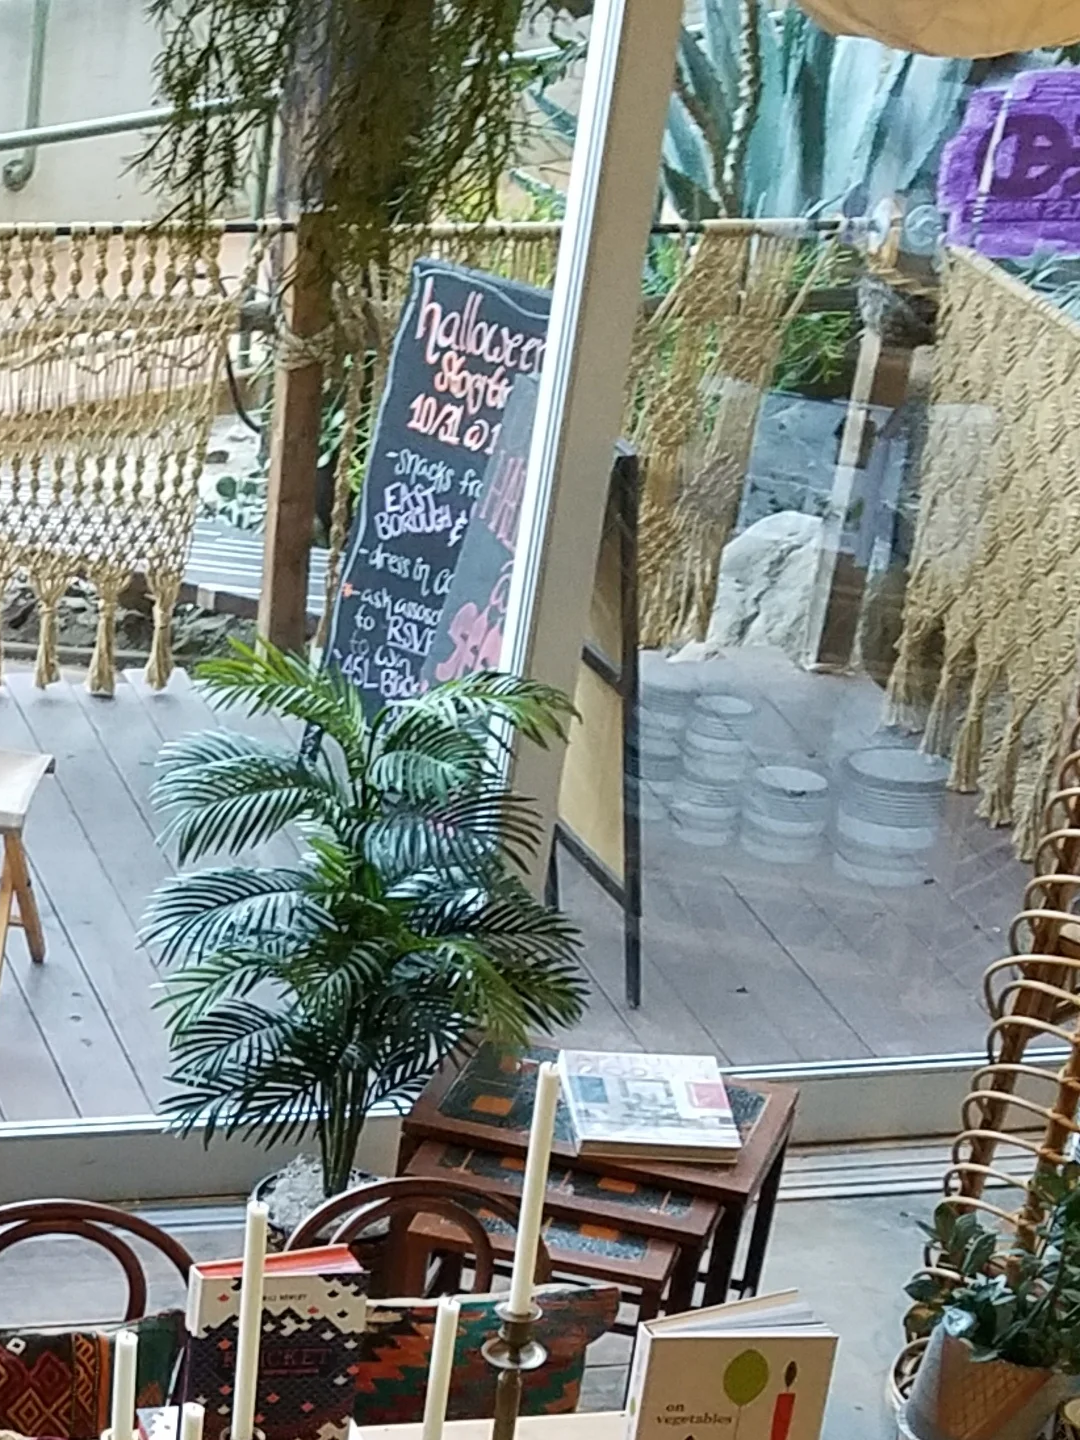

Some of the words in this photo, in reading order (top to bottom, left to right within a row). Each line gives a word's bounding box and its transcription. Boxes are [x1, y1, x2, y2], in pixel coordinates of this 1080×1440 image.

[384, 481, 435, 513] EAST
[412, 556, 430, 596] in
[354, 604, 376, 631] to
[656, 1412, 733, 1426] vegetables
[665, 1403, 685, 1413] on
